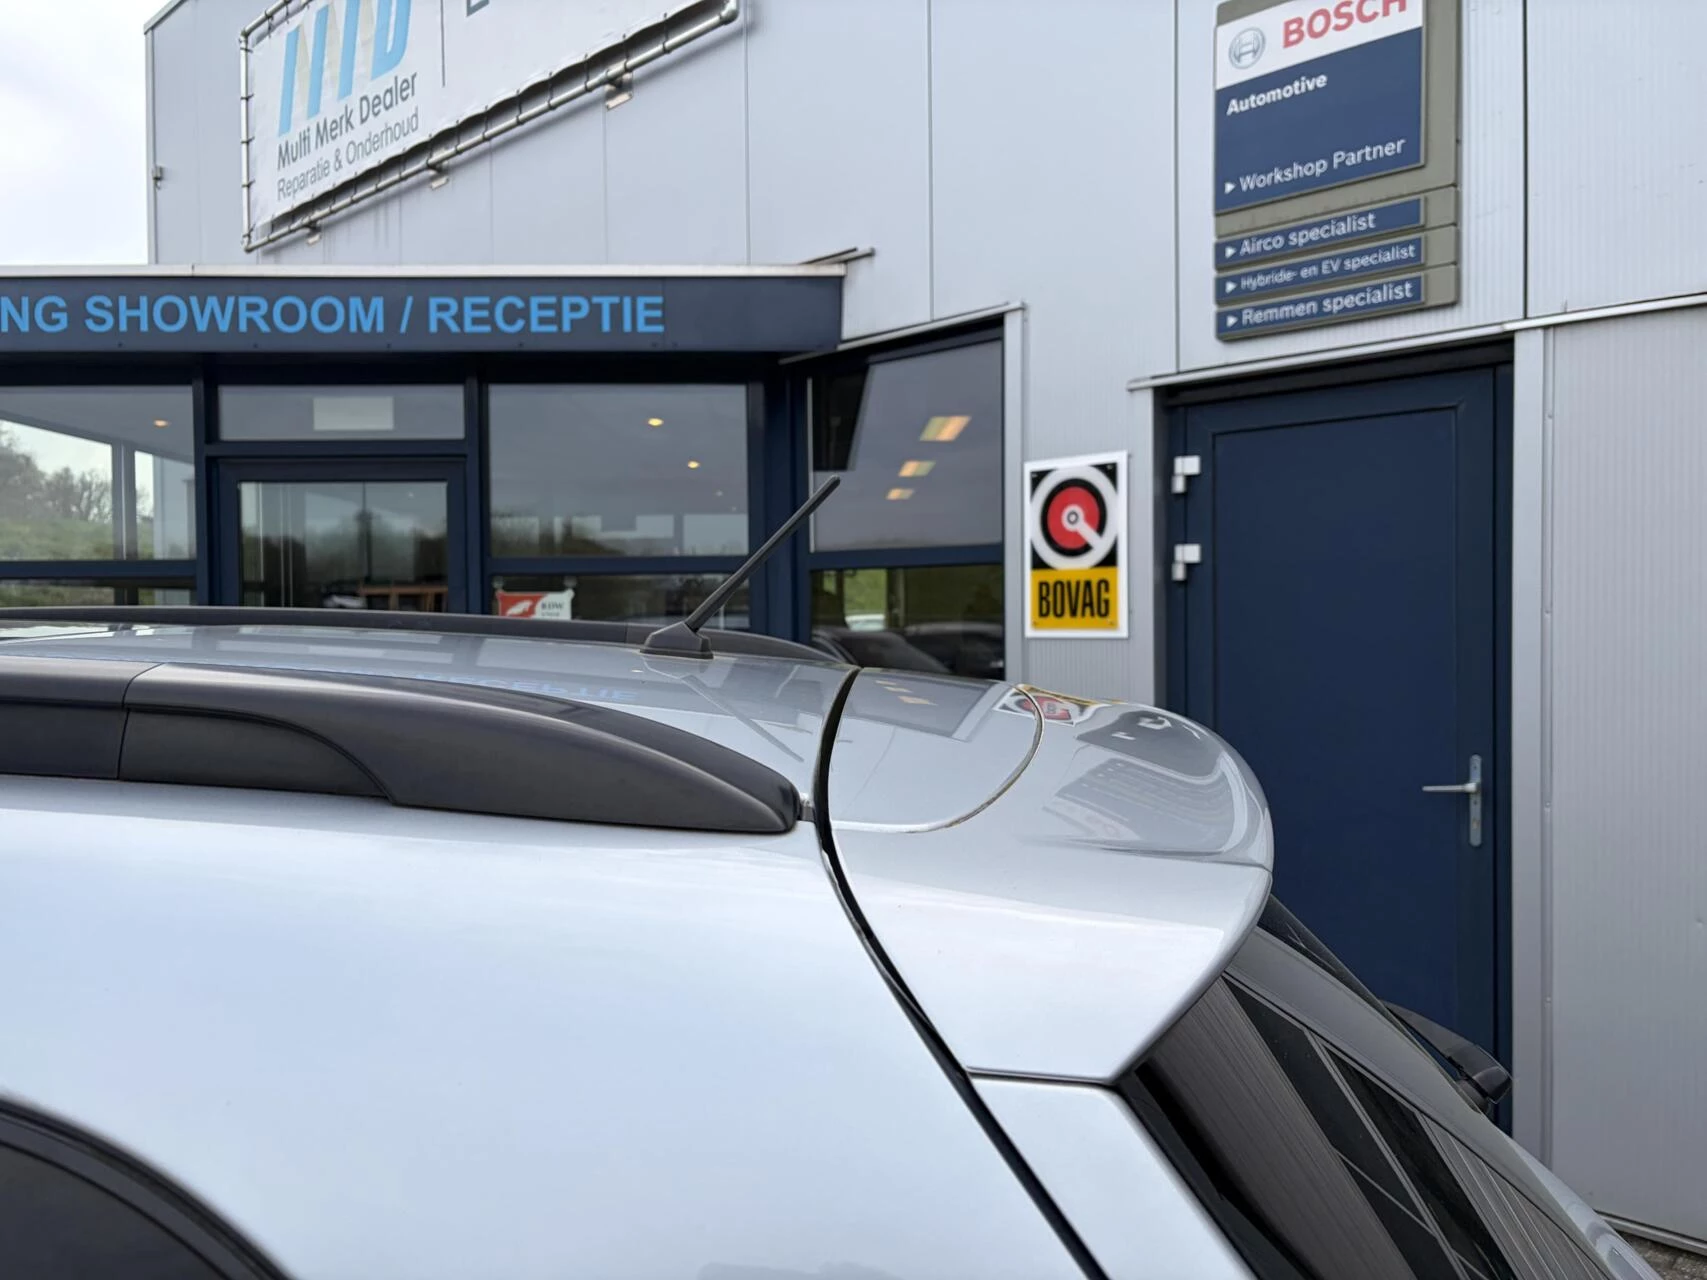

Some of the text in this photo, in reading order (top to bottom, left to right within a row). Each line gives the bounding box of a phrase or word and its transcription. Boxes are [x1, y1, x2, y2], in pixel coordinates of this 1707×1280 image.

[1283, 0, 1408, 49] BOSCH
[1226, 73, 1328, 117] Automotive
[277, 72, 418, 171] Multi Merk Dealer
[277, 105, 419, 201] Reparatie & Onderhoud
[1239, 138, 1406, 192] Workshop Partner
[1240, 213, 1377, 256] Airco specialist
[1241, 244, 1416, 291] Hybride- en EV specialist
[84, 294, 385, 334] SHOWROOM
[400, 295, 413, 333] /
[428, 295, 665, 334] RECEPTIE
[1242, 281, 1413, 326] Remmen specialist
[1038, 579, 1110, 618] BOVAG
